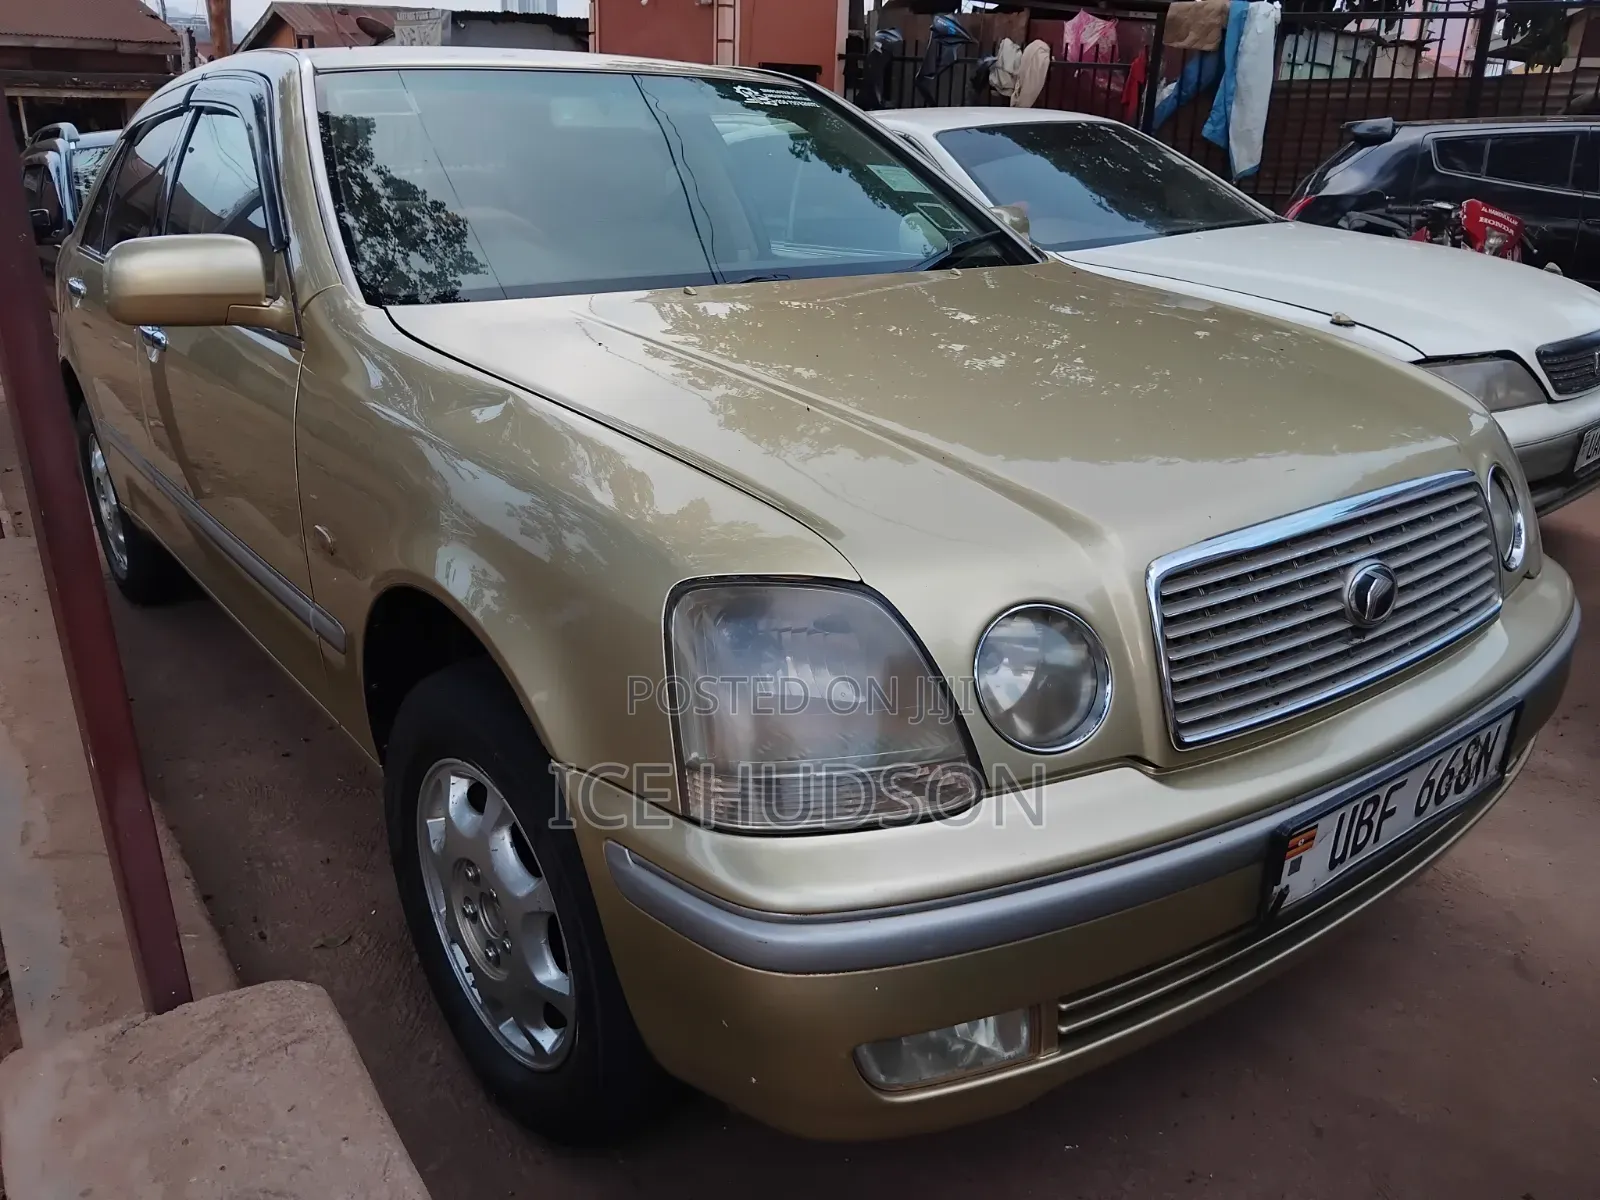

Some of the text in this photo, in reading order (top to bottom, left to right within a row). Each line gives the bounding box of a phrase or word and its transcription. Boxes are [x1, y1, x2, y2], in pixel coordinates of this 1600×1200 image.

[1479, 216, 1515, 236] HONDA
[1328, 724, 1502, 871] UBF 668N
